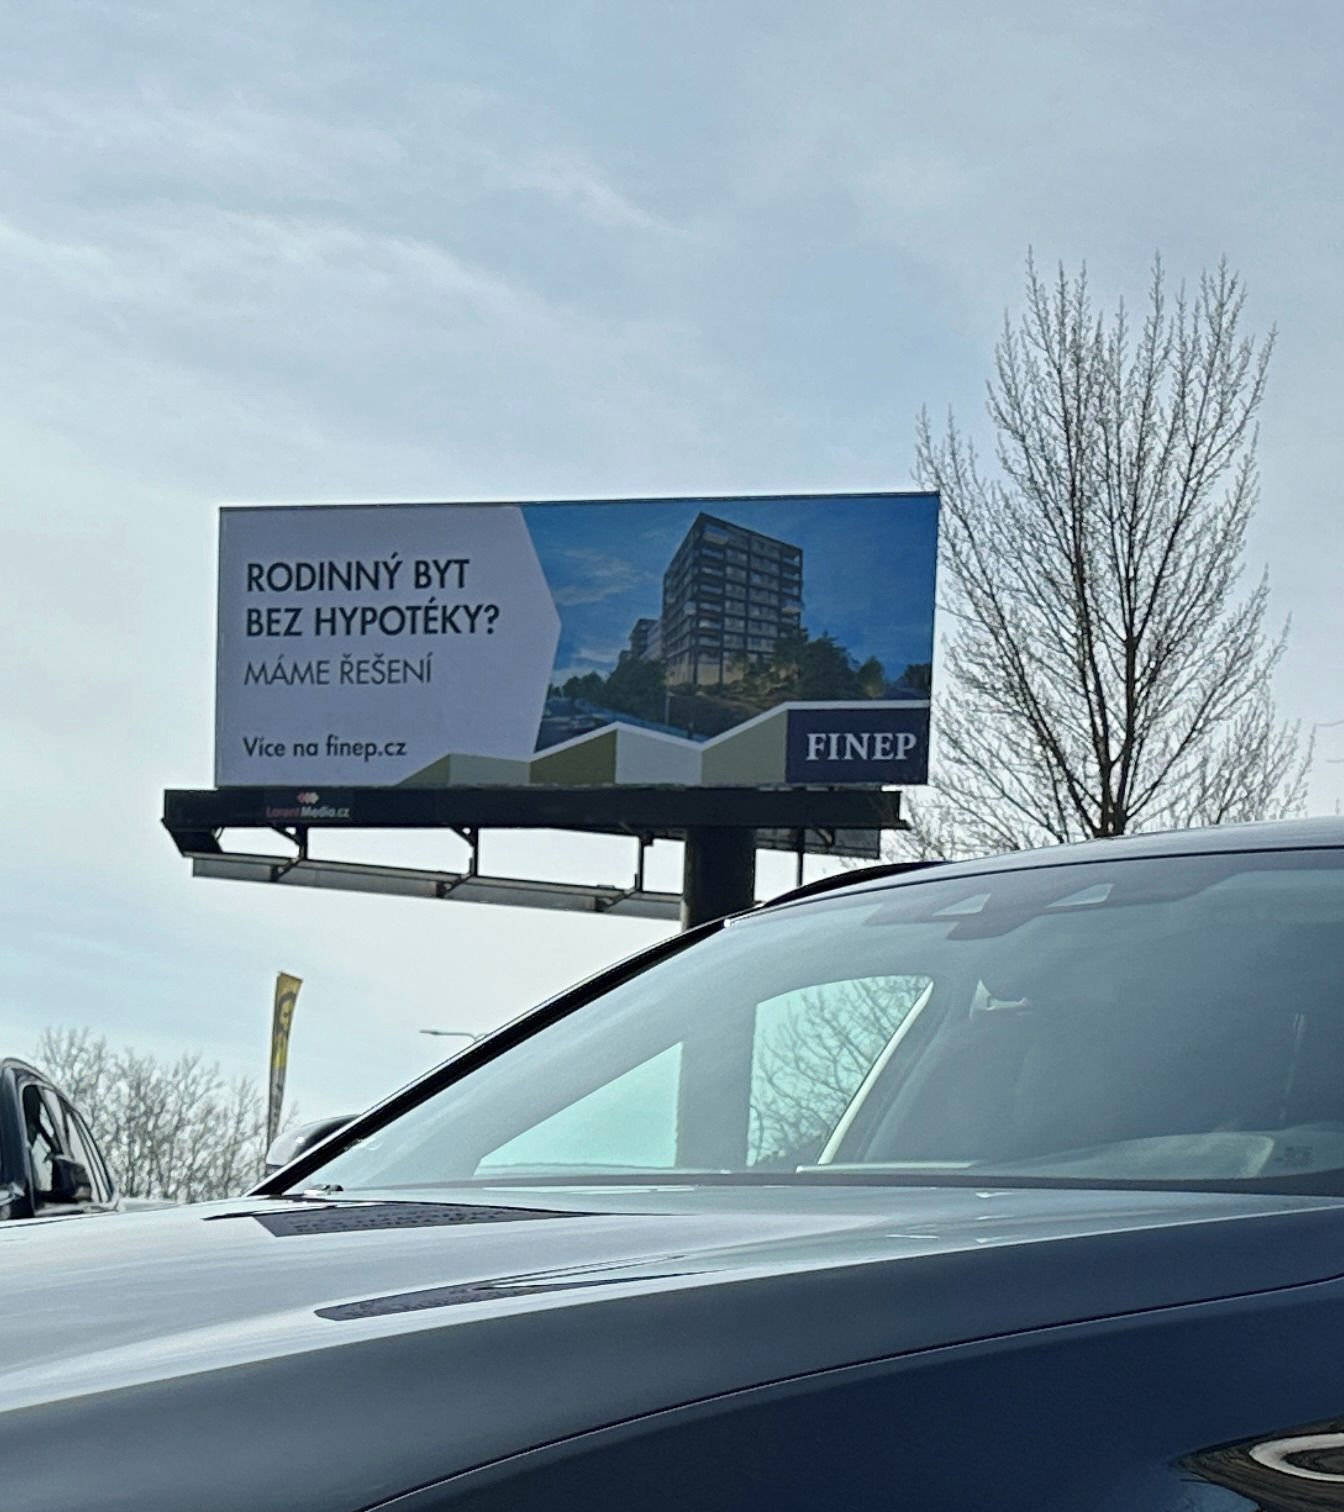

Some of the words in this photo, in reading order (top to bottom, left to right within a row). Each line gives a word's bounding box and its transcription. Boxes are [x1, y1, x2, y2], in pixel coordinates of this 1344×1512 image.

[247, 551, 403, 593] RODINNÝ
[414, 558, 470, 590] BYT
[246, 607, 304, 637] BEZ
[314, 596, 501, 636] HYPOTÉKY?
[244, 653, 331, 686] MÁME
[340, 651, 433, 686] ŘEŠENÍ
[242, 736, 286, 757] Více
[293, 742, 319, 757] na
[326, 733, 408, 763] finep.cz
[806, 732, 917, 761] FINEP
